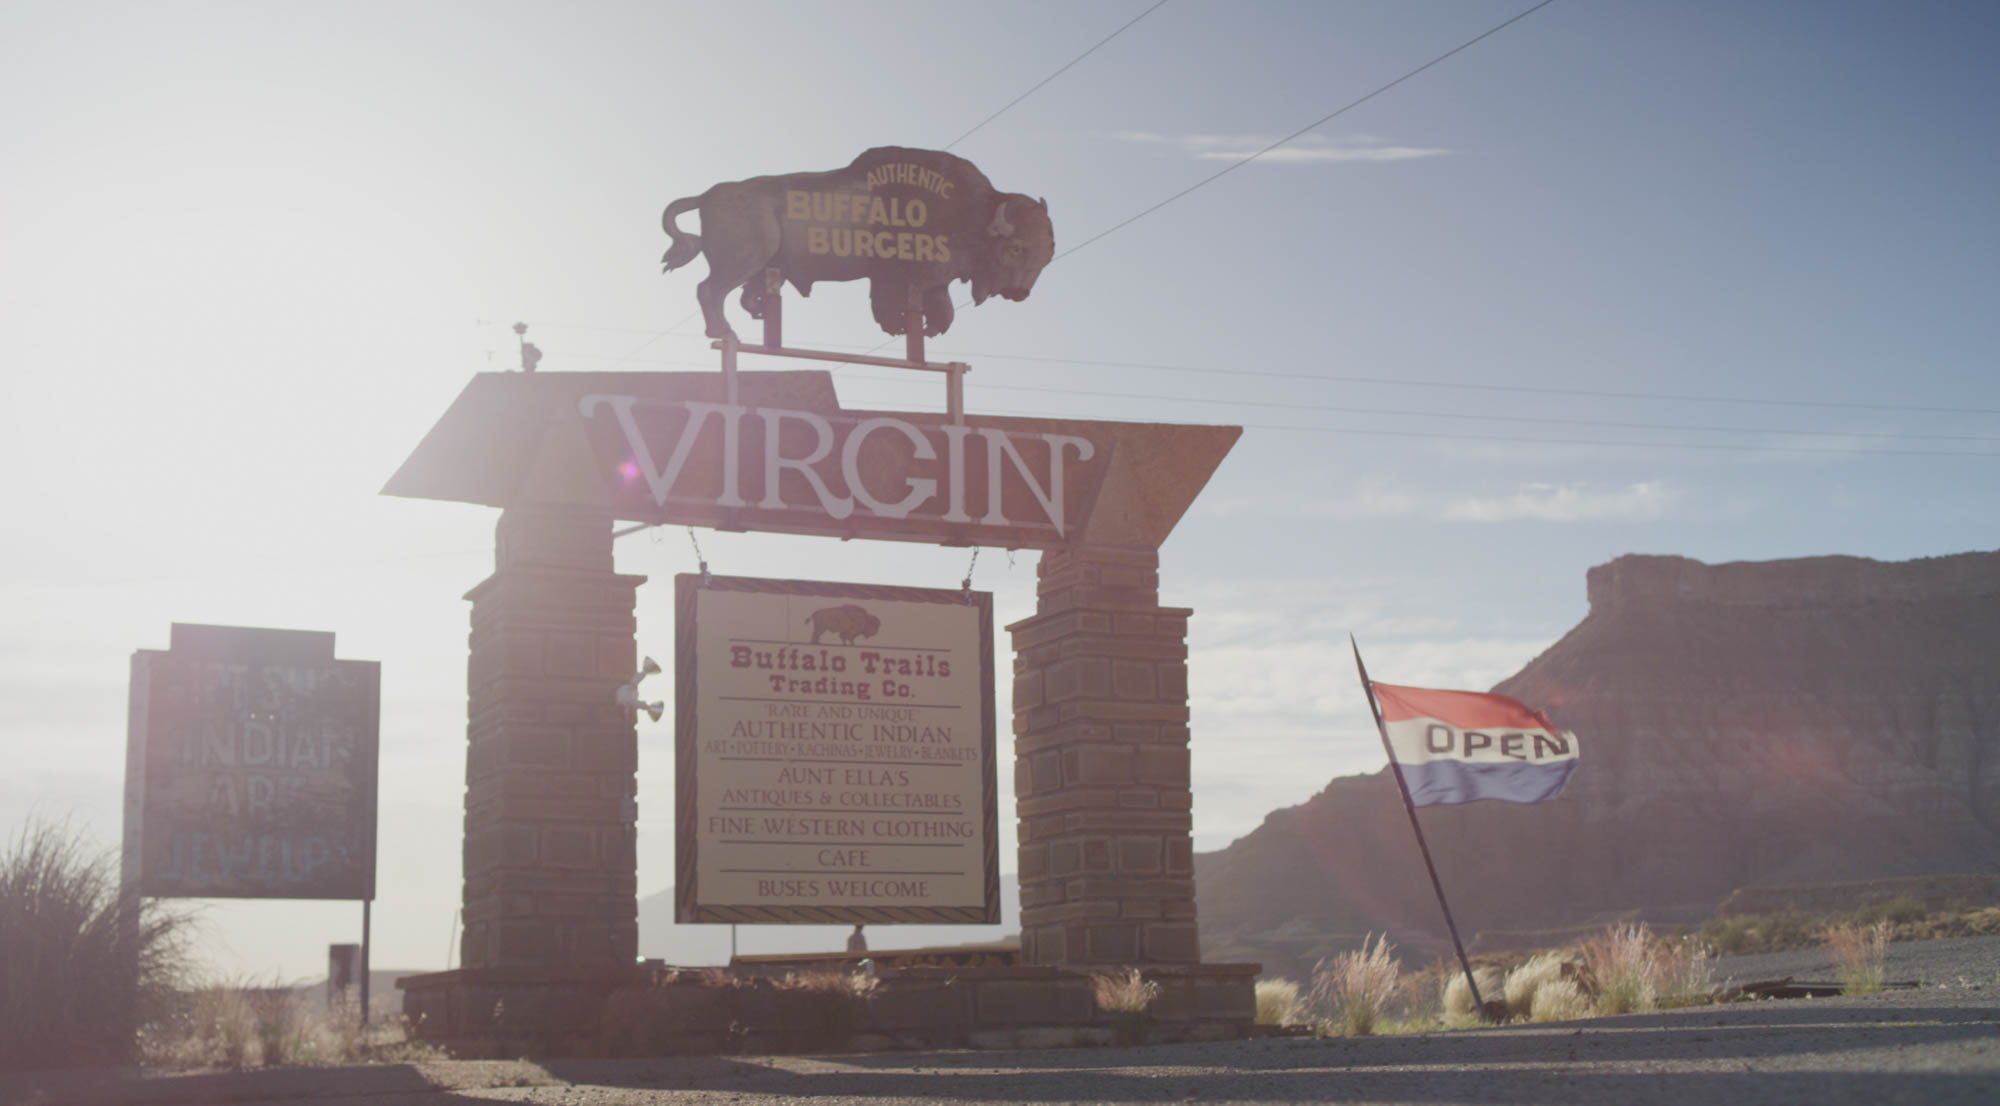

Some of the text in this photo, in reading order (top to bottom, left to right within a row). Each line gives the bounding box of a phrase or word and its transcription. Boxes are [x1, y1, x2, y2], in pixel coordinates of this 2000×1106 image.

[867, 162, 955, 200] AUTHENTIC
[786, 189, 927, 228] BUFFALO
[808, 226, 950, 263] BURGERS
[577, 393, 1095, 540] VIRGIN
[730, 646, 951, 677] Buffalo Trails
[769, 675, 916, 700] Trading Co.
[818, 706, 853, 719] AND
[731, 720, 952, 743] AUTHENTIC INDIAN
[1426, 723, 1570, 760] OPEN
[704, 740, 979, 761] ART POTTERY KACHINAS JEWELRY BLANKETS
[778, 767, 909, 787] AUNT ELLA'S
[722, 789, 963, 808] ANTIQUES & COLLECTABLES
[708, 817, 974, 838] FINE WESTERN CLOTHING
[818, 849, 870, 866] CAFE
[758, 880, 929, 898] BUSES WELCOME
